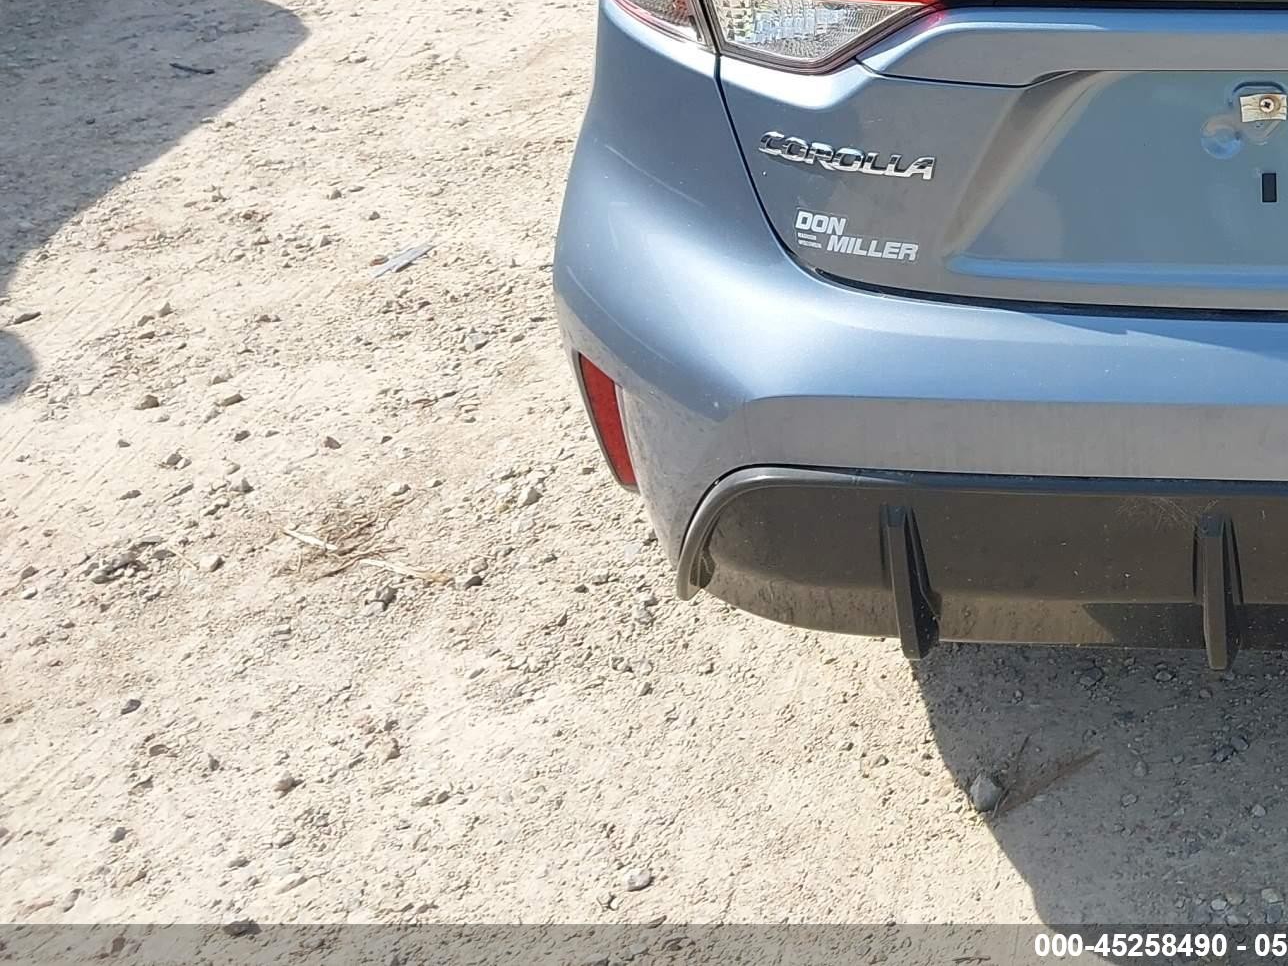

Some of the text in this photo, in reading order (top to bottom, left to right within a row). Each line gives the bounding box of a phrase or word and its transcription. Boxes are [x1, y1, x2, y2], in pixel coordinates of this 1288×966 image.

[757, 131, 936, 180] COROLLA
[795, 210, 846, 235] DON
[827, 234, 919, 261] MILLER
